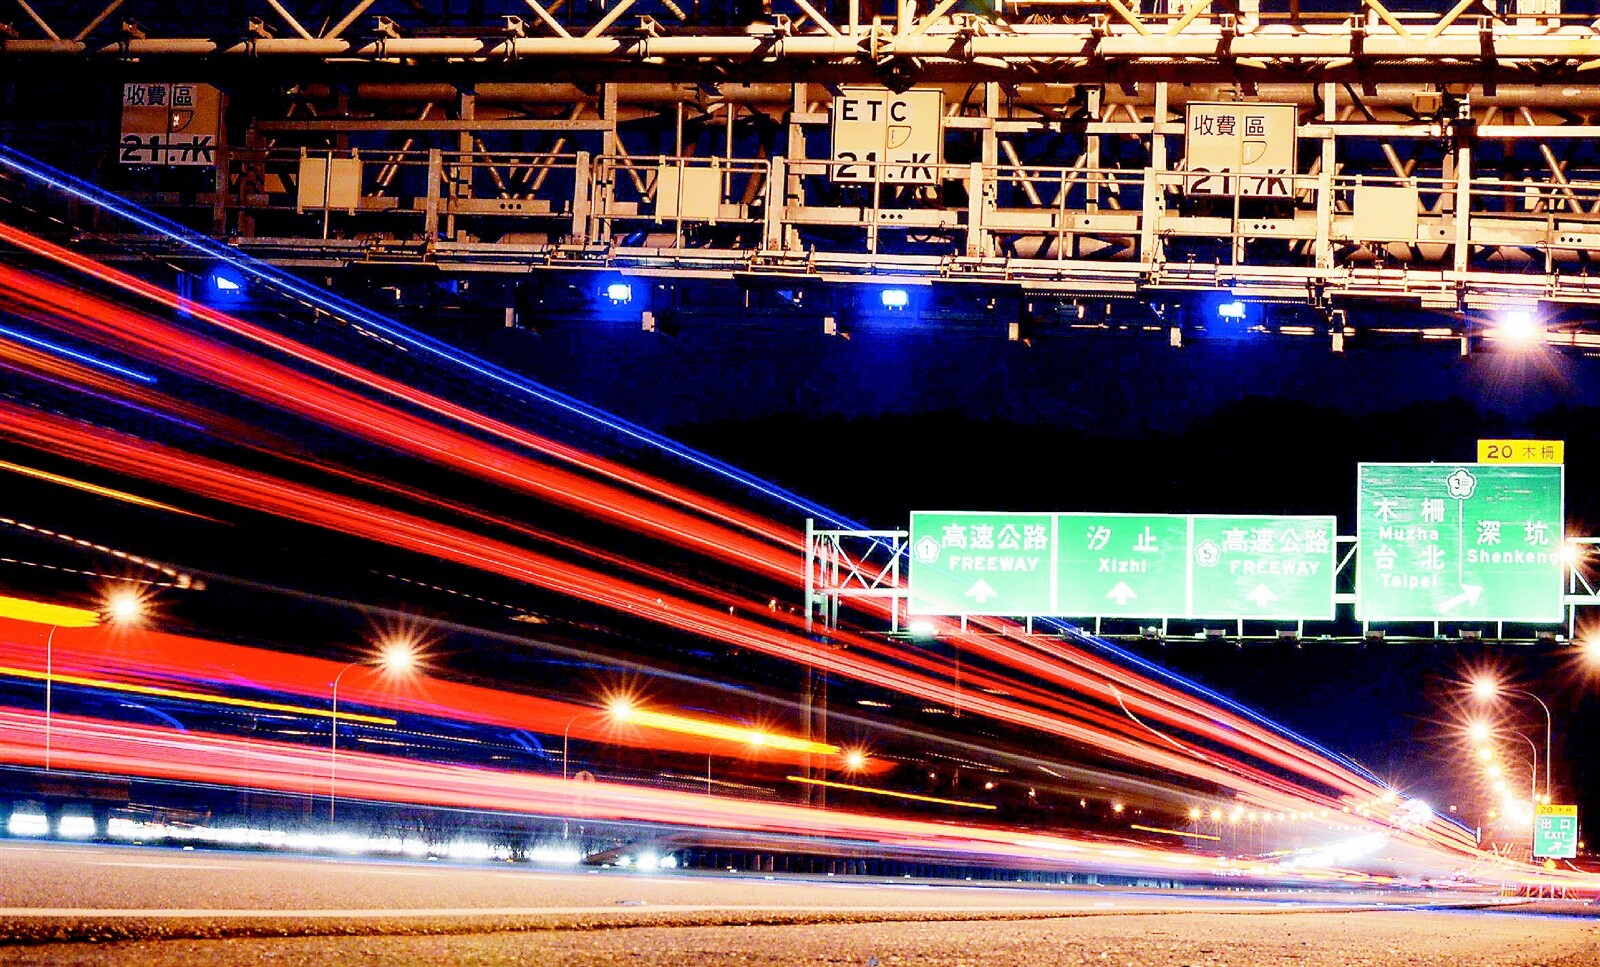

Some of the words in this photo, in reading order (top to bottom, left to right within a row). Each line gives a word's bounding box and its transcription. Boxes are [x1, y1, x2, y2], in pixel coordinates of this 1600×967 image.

[126, 85, 193, 105] 收費區
[842, 99, 907, 122] ETC
[1194, 114, 1265, 136] 收費區
[836, 152, 932, 180] 21.7K
[1190, 168, 1288, 195] 21.7K
[1487, 445, 1513, 459] 20
[942, 523, 1049, 551] 高速公路
[1087, 525, 1159, 552] 汐止
[1221, 527, 1330, 554] 高速公路
[1379, 525, 1439, 541] Muzha
[1476, 520, 1549, 546] 深坑
[949, 556, 1040, 572] FREEWAY
[1098, 557, 1147, 573] Xizhi
[1373, 544, 1446, 571] 台北
[1466, 549, 1559, 565] Shenkeng
[1230, 560, 1320, 576] FREEWAY
[1382, 573, 1438, 592] Taipei
[1544, 832, 1566, 840] EXIT
